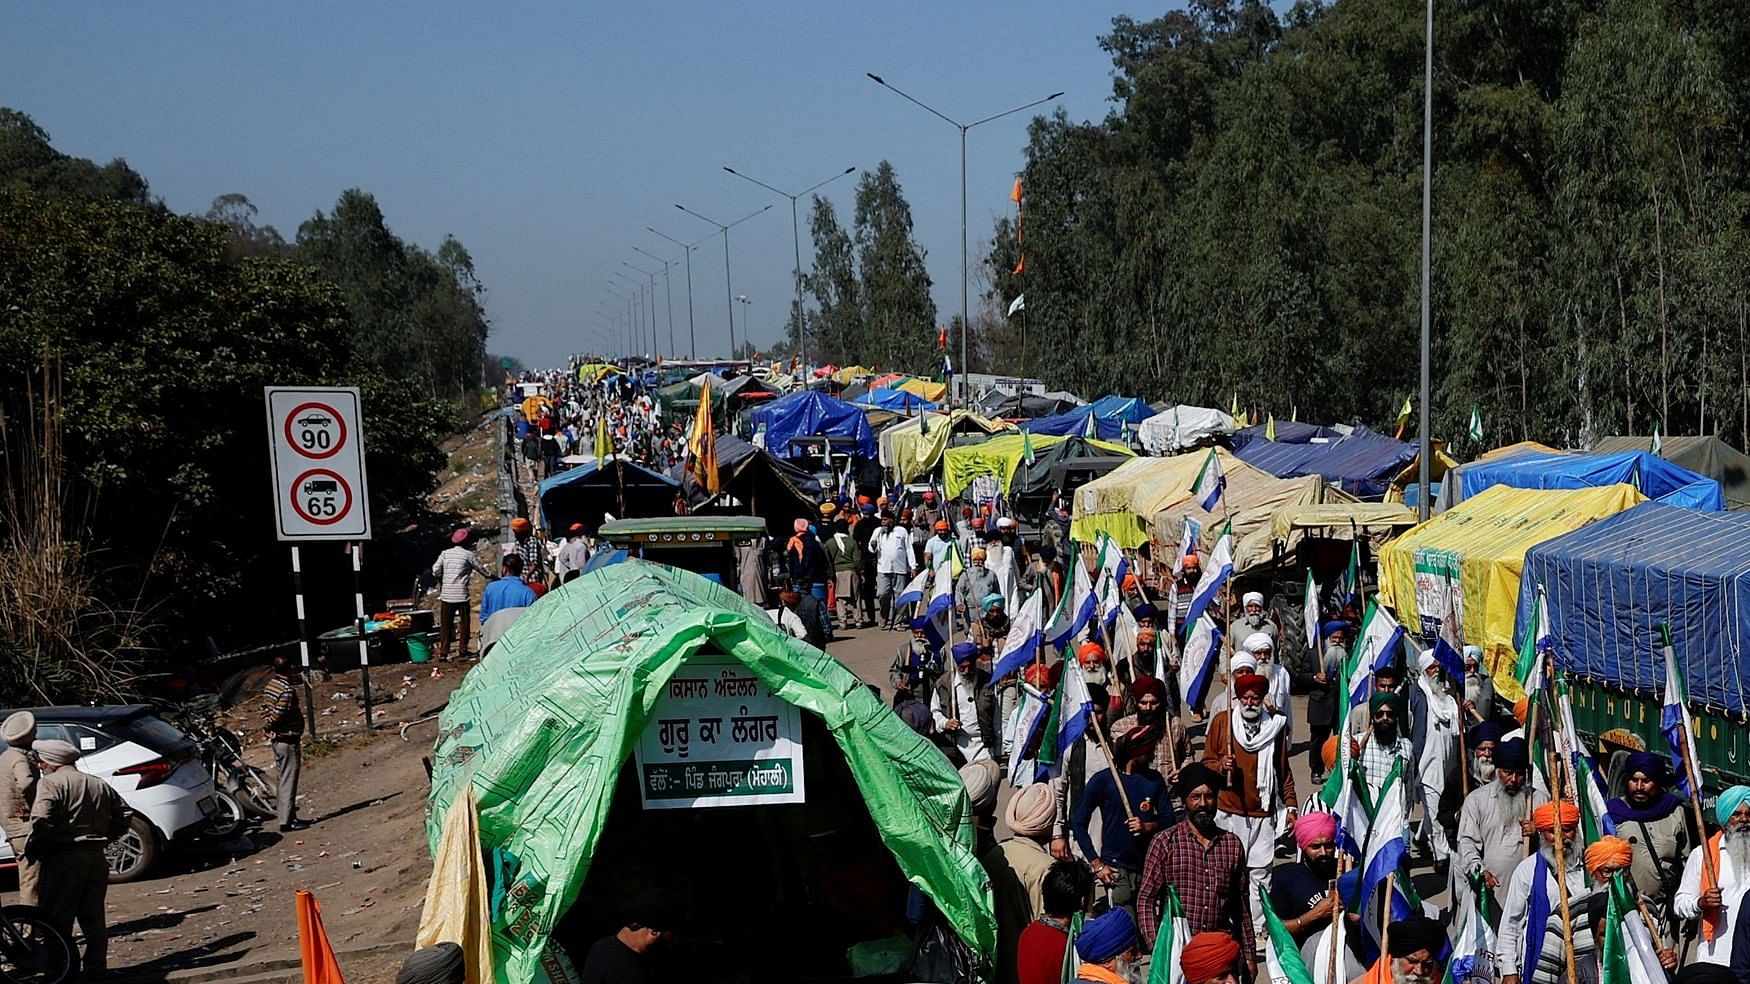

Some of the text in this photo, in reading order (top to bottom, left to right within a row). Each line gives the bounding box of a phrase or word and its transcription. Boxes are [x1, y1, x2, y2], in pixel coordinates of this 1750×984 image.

[302, 429, 330, 449] 90
[308, 496, 336, 516] 65
[658, 705, 778, 758] ਗੁਰੂ ਕਾ ਲੰਗਰ
[684, 766, 704, 790] ਪਿੰਡ
[747, 763, 787, 790] (ਮੋਹਾਲੀ)
